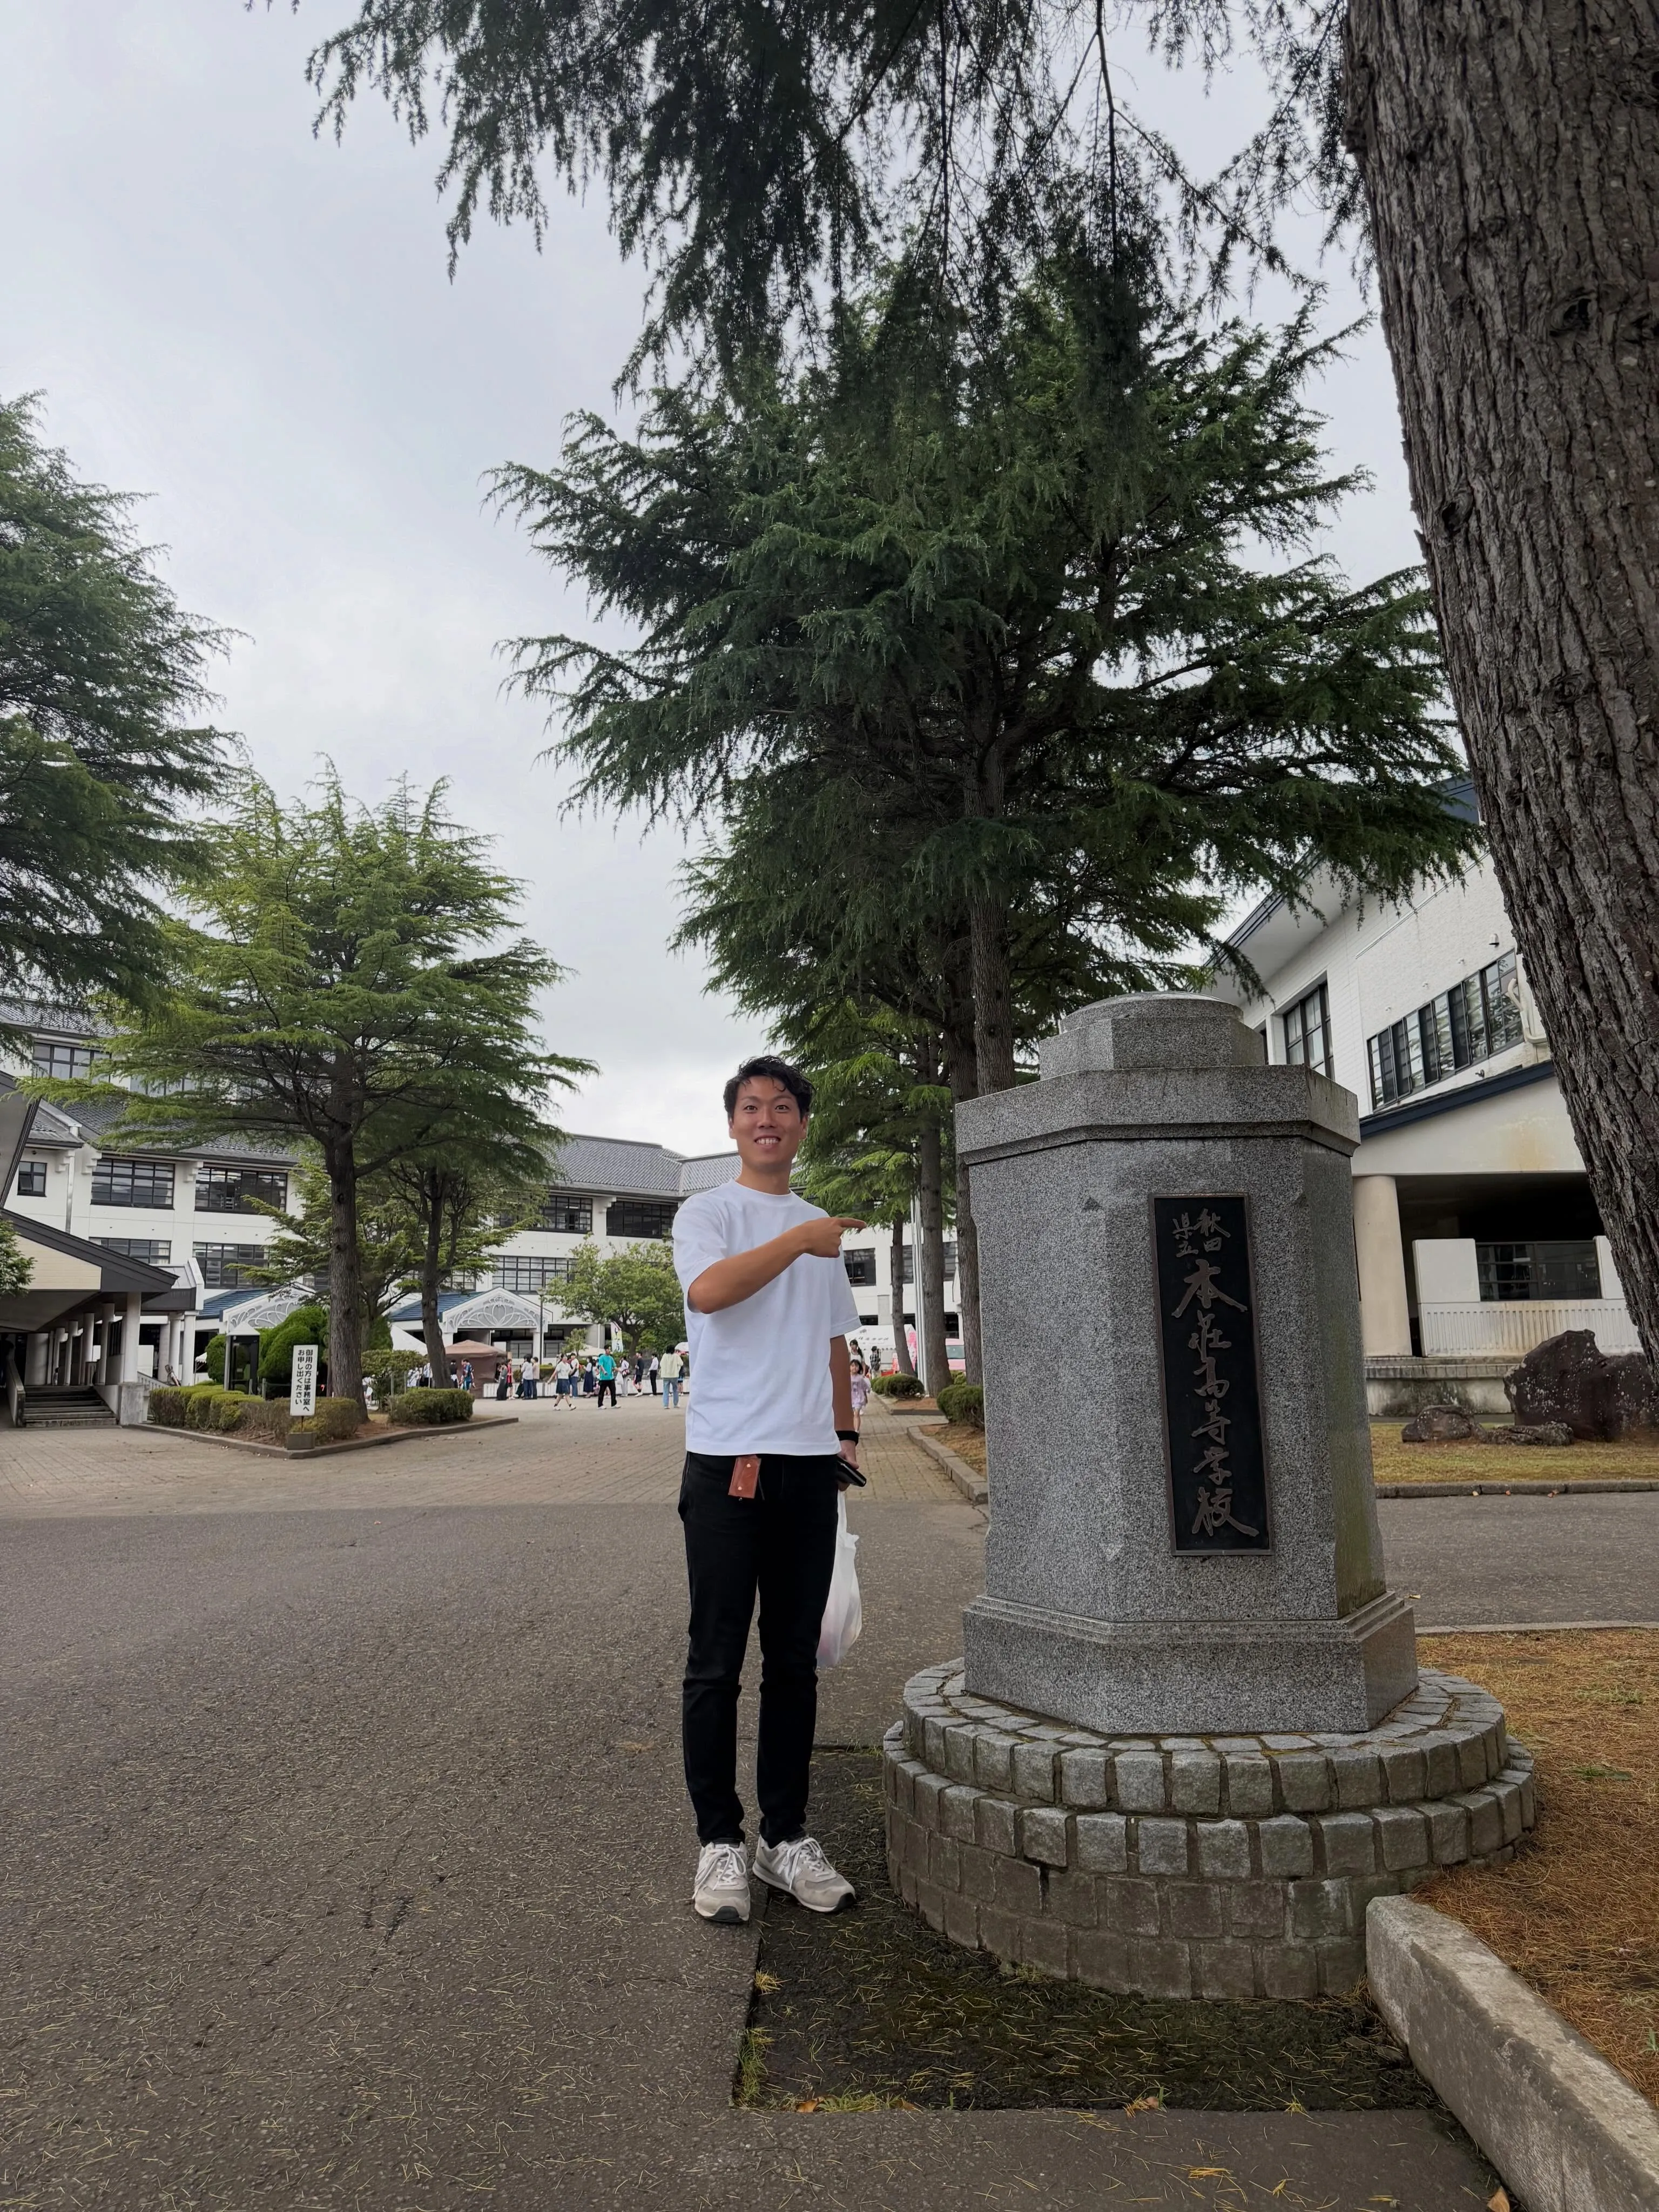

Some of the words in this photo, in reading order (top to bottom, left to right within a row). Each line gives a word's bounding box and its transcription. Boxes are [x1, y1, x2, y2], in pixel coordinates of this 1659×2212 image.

[295, 1349, 305, 1405] お申し出ください
[303, 1349, 313, 1412] 御用の方は事務室へ
